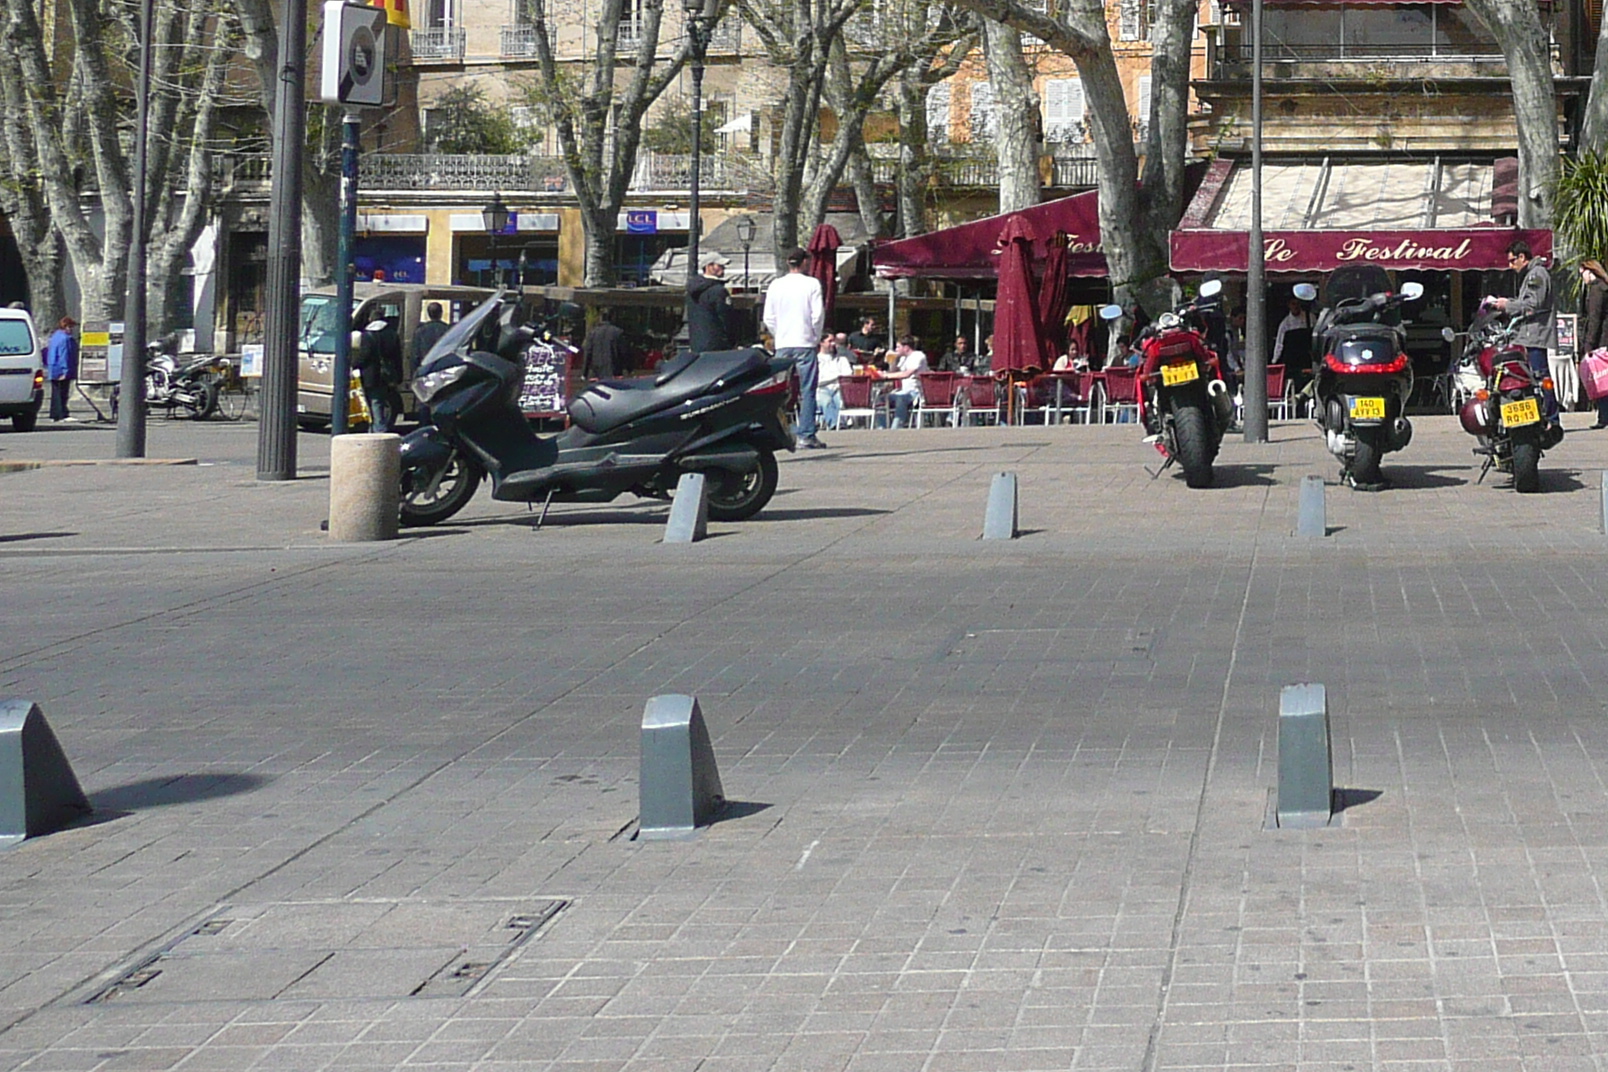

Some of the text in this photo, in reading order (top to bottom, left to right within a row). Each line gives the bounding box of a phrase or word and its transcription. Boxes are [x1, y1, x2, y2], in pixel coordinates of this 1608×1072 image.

[627, 213, 652, 225] LCL
[1335, 238, 1473, 261] Festival
[1524, 410, 1535, 421] 13
